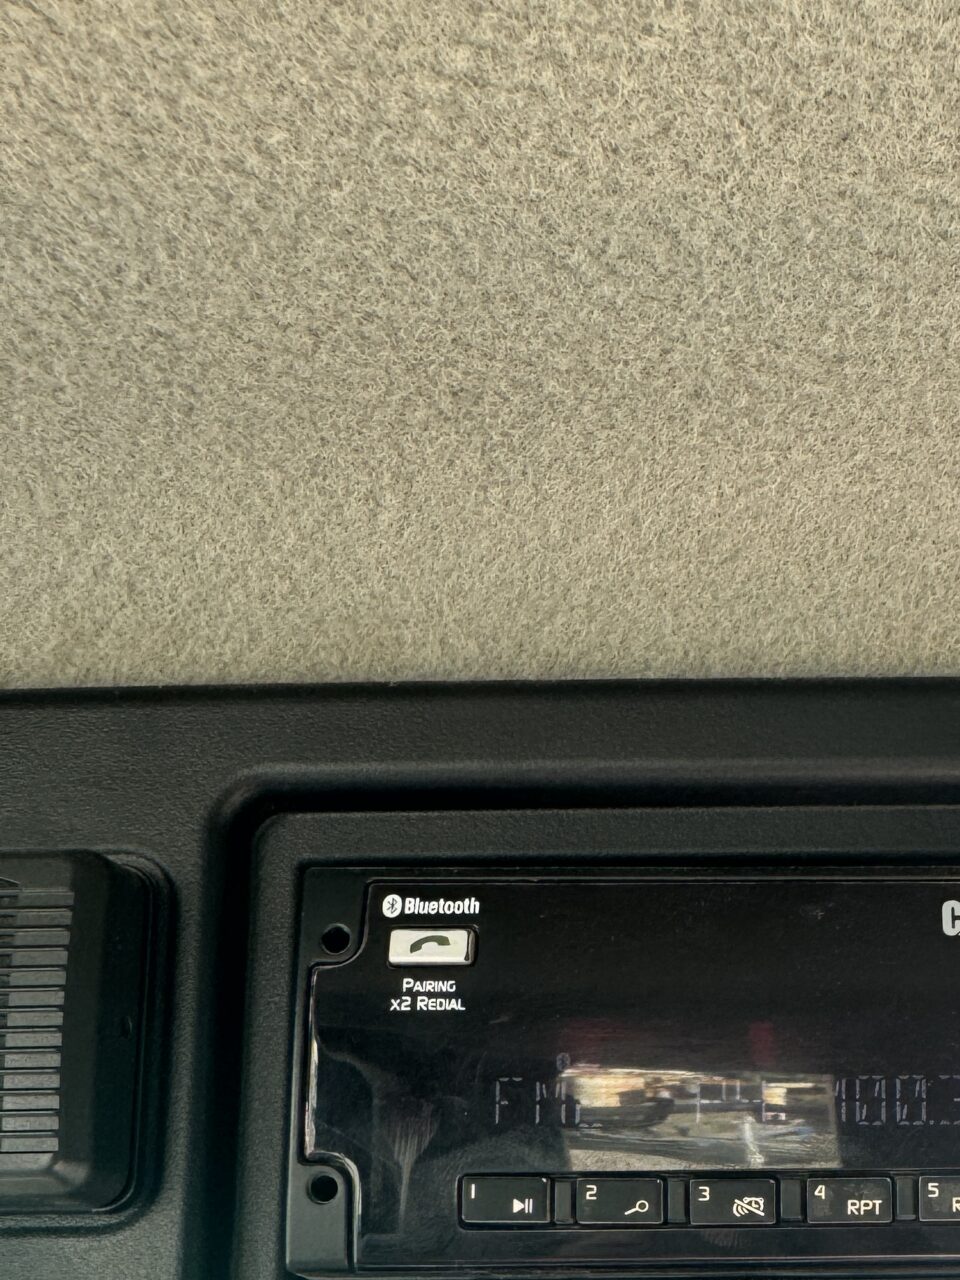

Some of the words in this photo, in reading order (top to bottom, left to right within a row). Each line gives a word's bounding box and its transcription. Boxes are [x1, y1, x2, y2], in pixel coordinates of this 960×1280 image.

[404, 898, 480, 915] Bluetooth
[585, 1185, 598, 1200] 2
[698, 1186, 710, 1201] 3
[814, 1184, 826, 1200] 4
[928, 1182, 939, 1197] 5
[847, 1199, 883, 1215] RPT
